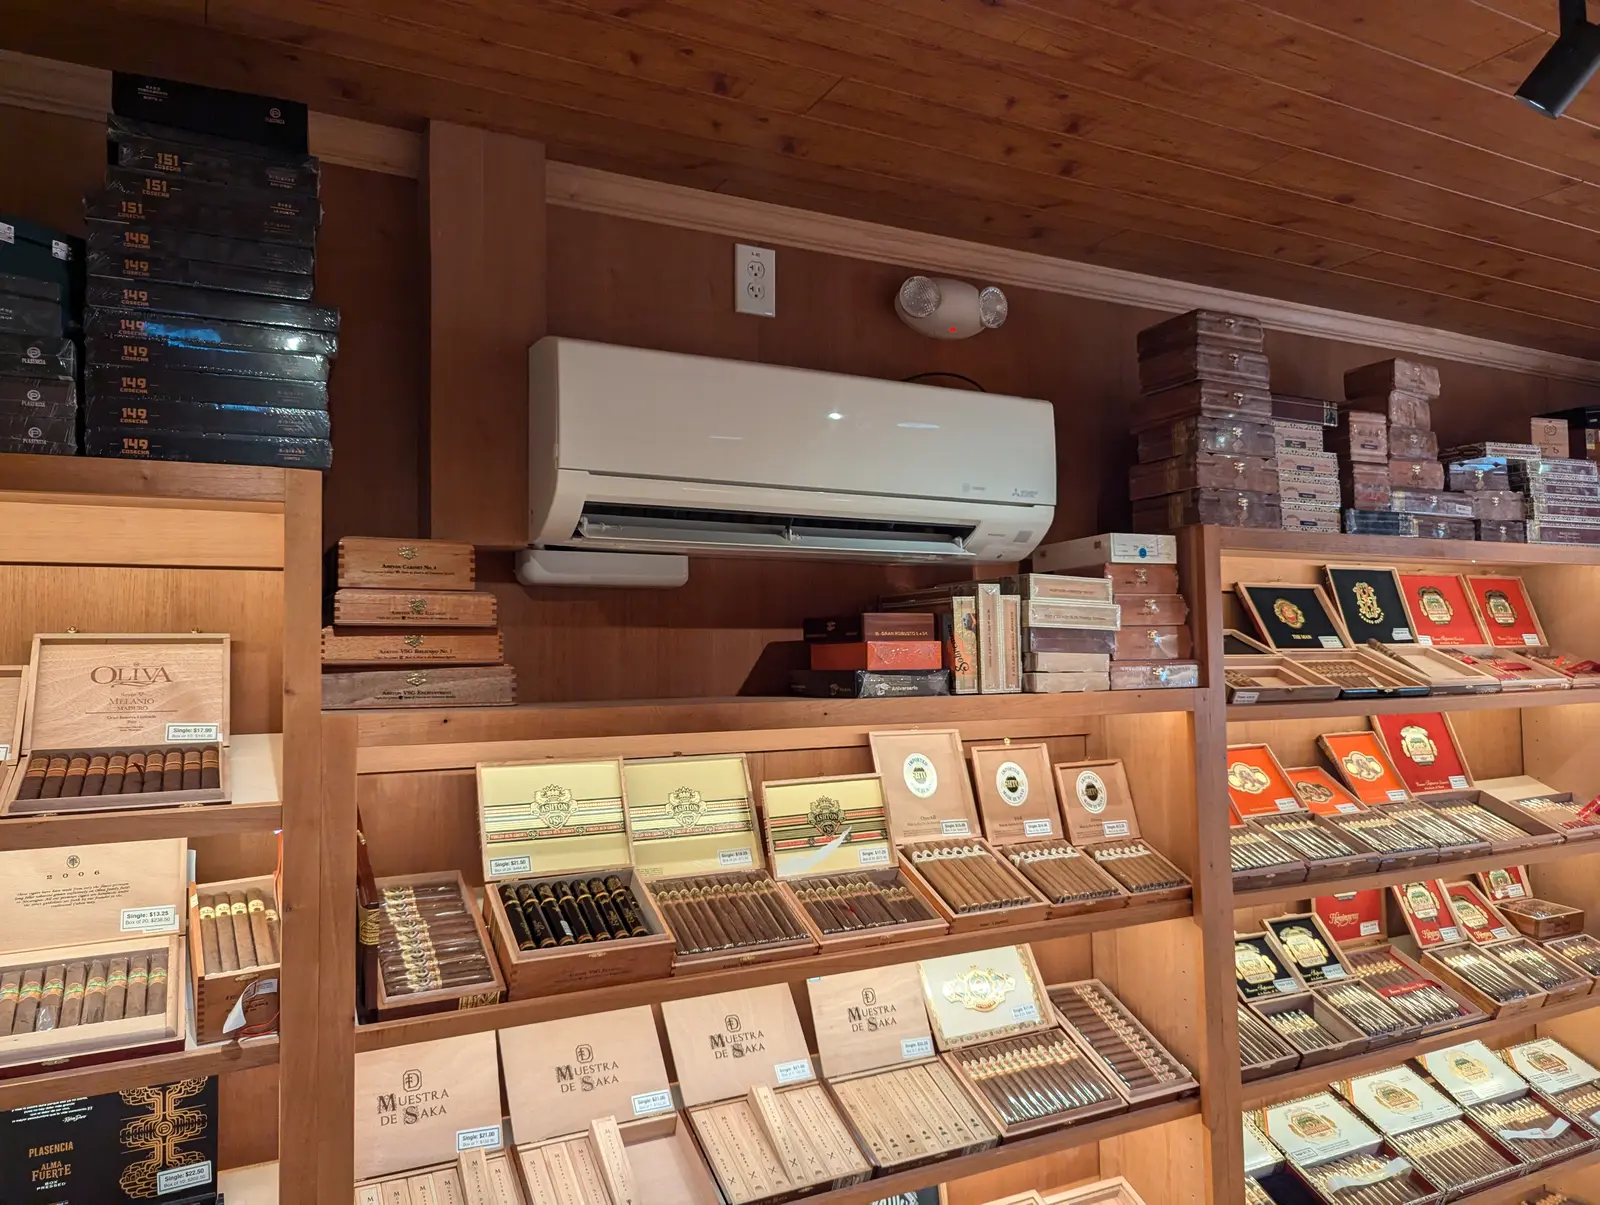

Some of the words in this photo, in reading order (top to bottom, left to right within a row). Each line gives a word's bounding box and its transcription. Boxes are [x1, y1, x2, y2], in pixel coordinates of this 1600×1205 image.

[157, 152, 178, 166] 151
[145, 178, 167, 192] 151
[122, 201, 143, 214] 151
[124, 232, 149, 244] 149
[124, 259, 149, 272] 149
[123, 289, 148, 301] 149
[120, 319, 145, 331] 149
[123, 345, 148, 357] 149
[122, 377, 146, 388] 149
[122, 407, 147, 419] 149
[123, 438, 148, 450] 149
[91, 664, 173, 686] OLIVA
[541, 802, 568, 812] ASHTON
[675, 804, 699, 812] ASHTON
[848, 1004, 897, 1023] MUESTRA
[852, 1023, 863, 1032] DE
[867, 1017, 897, 1032] SAKA
[709, 1030, 764, 1050] MUESTRA
[715, 1050, 728, 1059] DE
[732, 1043, 765, 1058] SAKA
[555, 1061, 619, 1083] MUESTRA
[561, 1083, 576, 1093] DE
[580, 1074, 619, 1092] SAKA
[377, 1088, 449, 1114] MUESTRA
[381, 1114, 397, 1126] DE
[403, 1105, 447, 1125] SAKA
[29, 1141, 74, 1158] PLASENCIA
[41, 1161, 62, 1170] ALMA
[32, 1164, 72, 1182] FUERTE
[165, 1174, 184, 1182] Single:
[185, 1168, 204, 1177] $22.50
